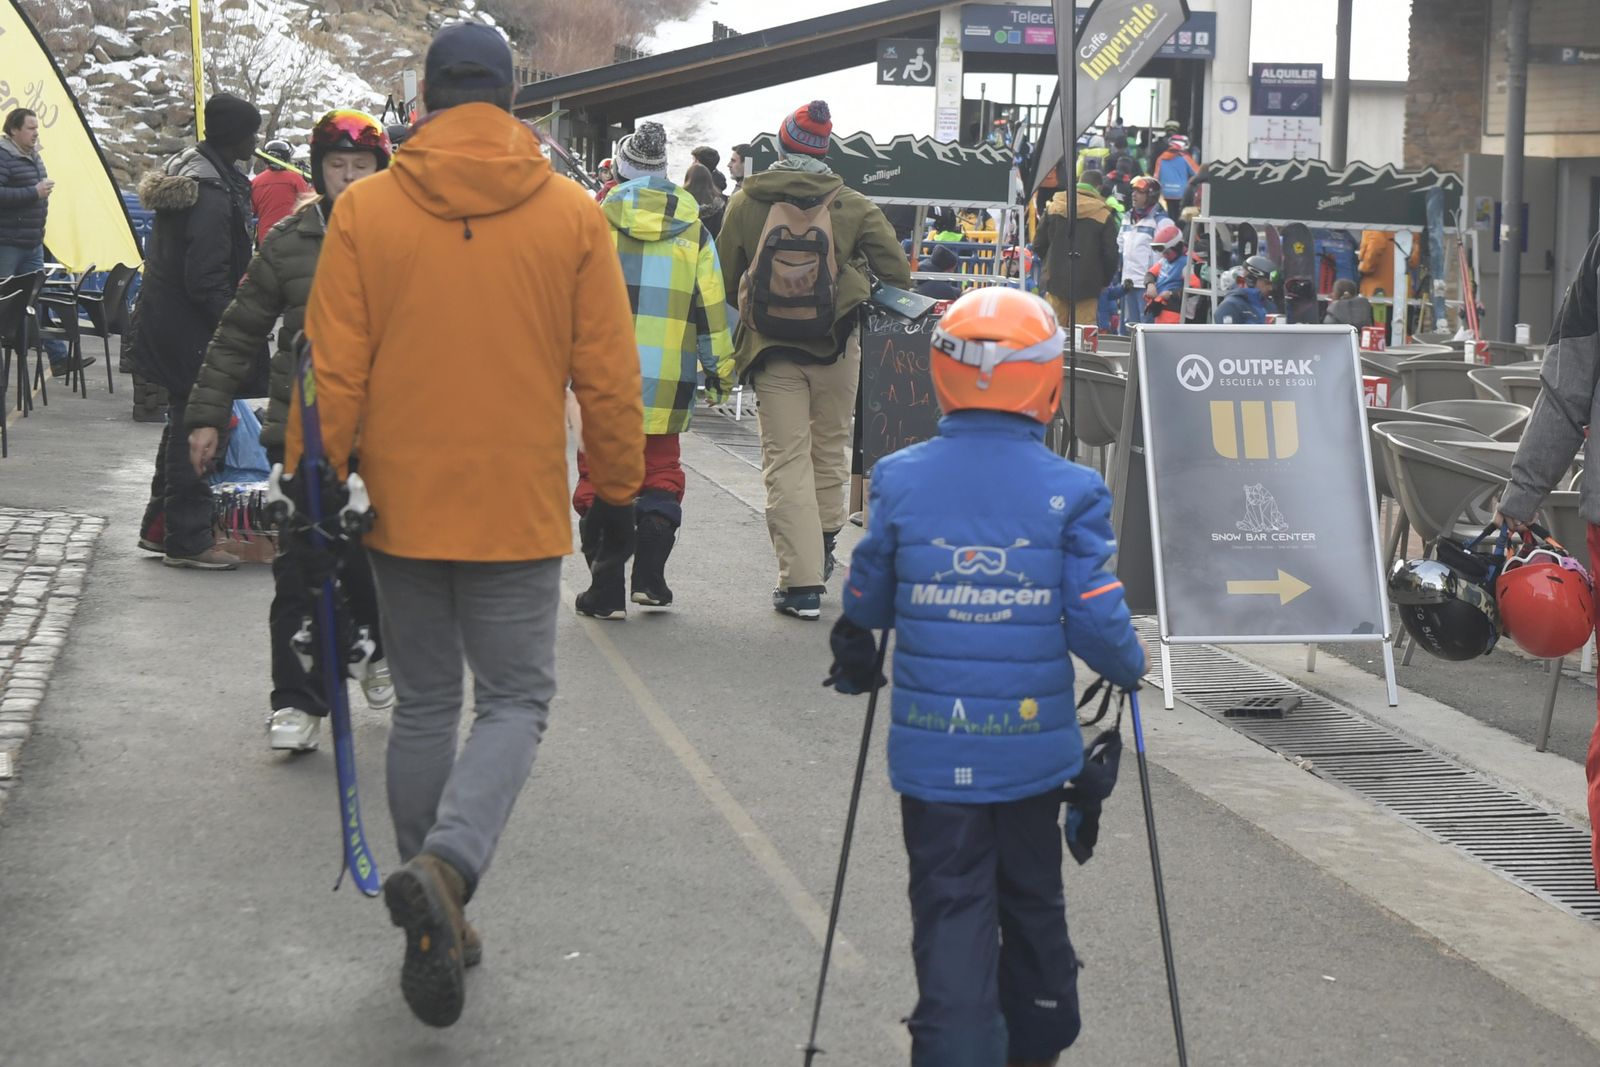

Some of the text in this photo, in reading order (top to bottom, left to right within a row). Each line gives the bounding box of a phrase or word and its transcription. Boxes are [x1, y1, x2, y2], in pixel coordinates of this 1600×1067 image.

[1079, 3, 1158, 81] Imperiale
[1079, 31, 1109, 59] Caffe
[1260, 68, 1318, 79] ALQUILER
[1218, 358, 1314, 376] OUTPEAK
[1219, 378, 1264, 387] ESCUELA
[1268, 378, 1281, 387] DE
[1211, 532, 1316, 541] SNOW BAR CENTER
[910, 581, 1052, 605] Mulhacén
[947, 608, 1013, 623] SKI CLUB
